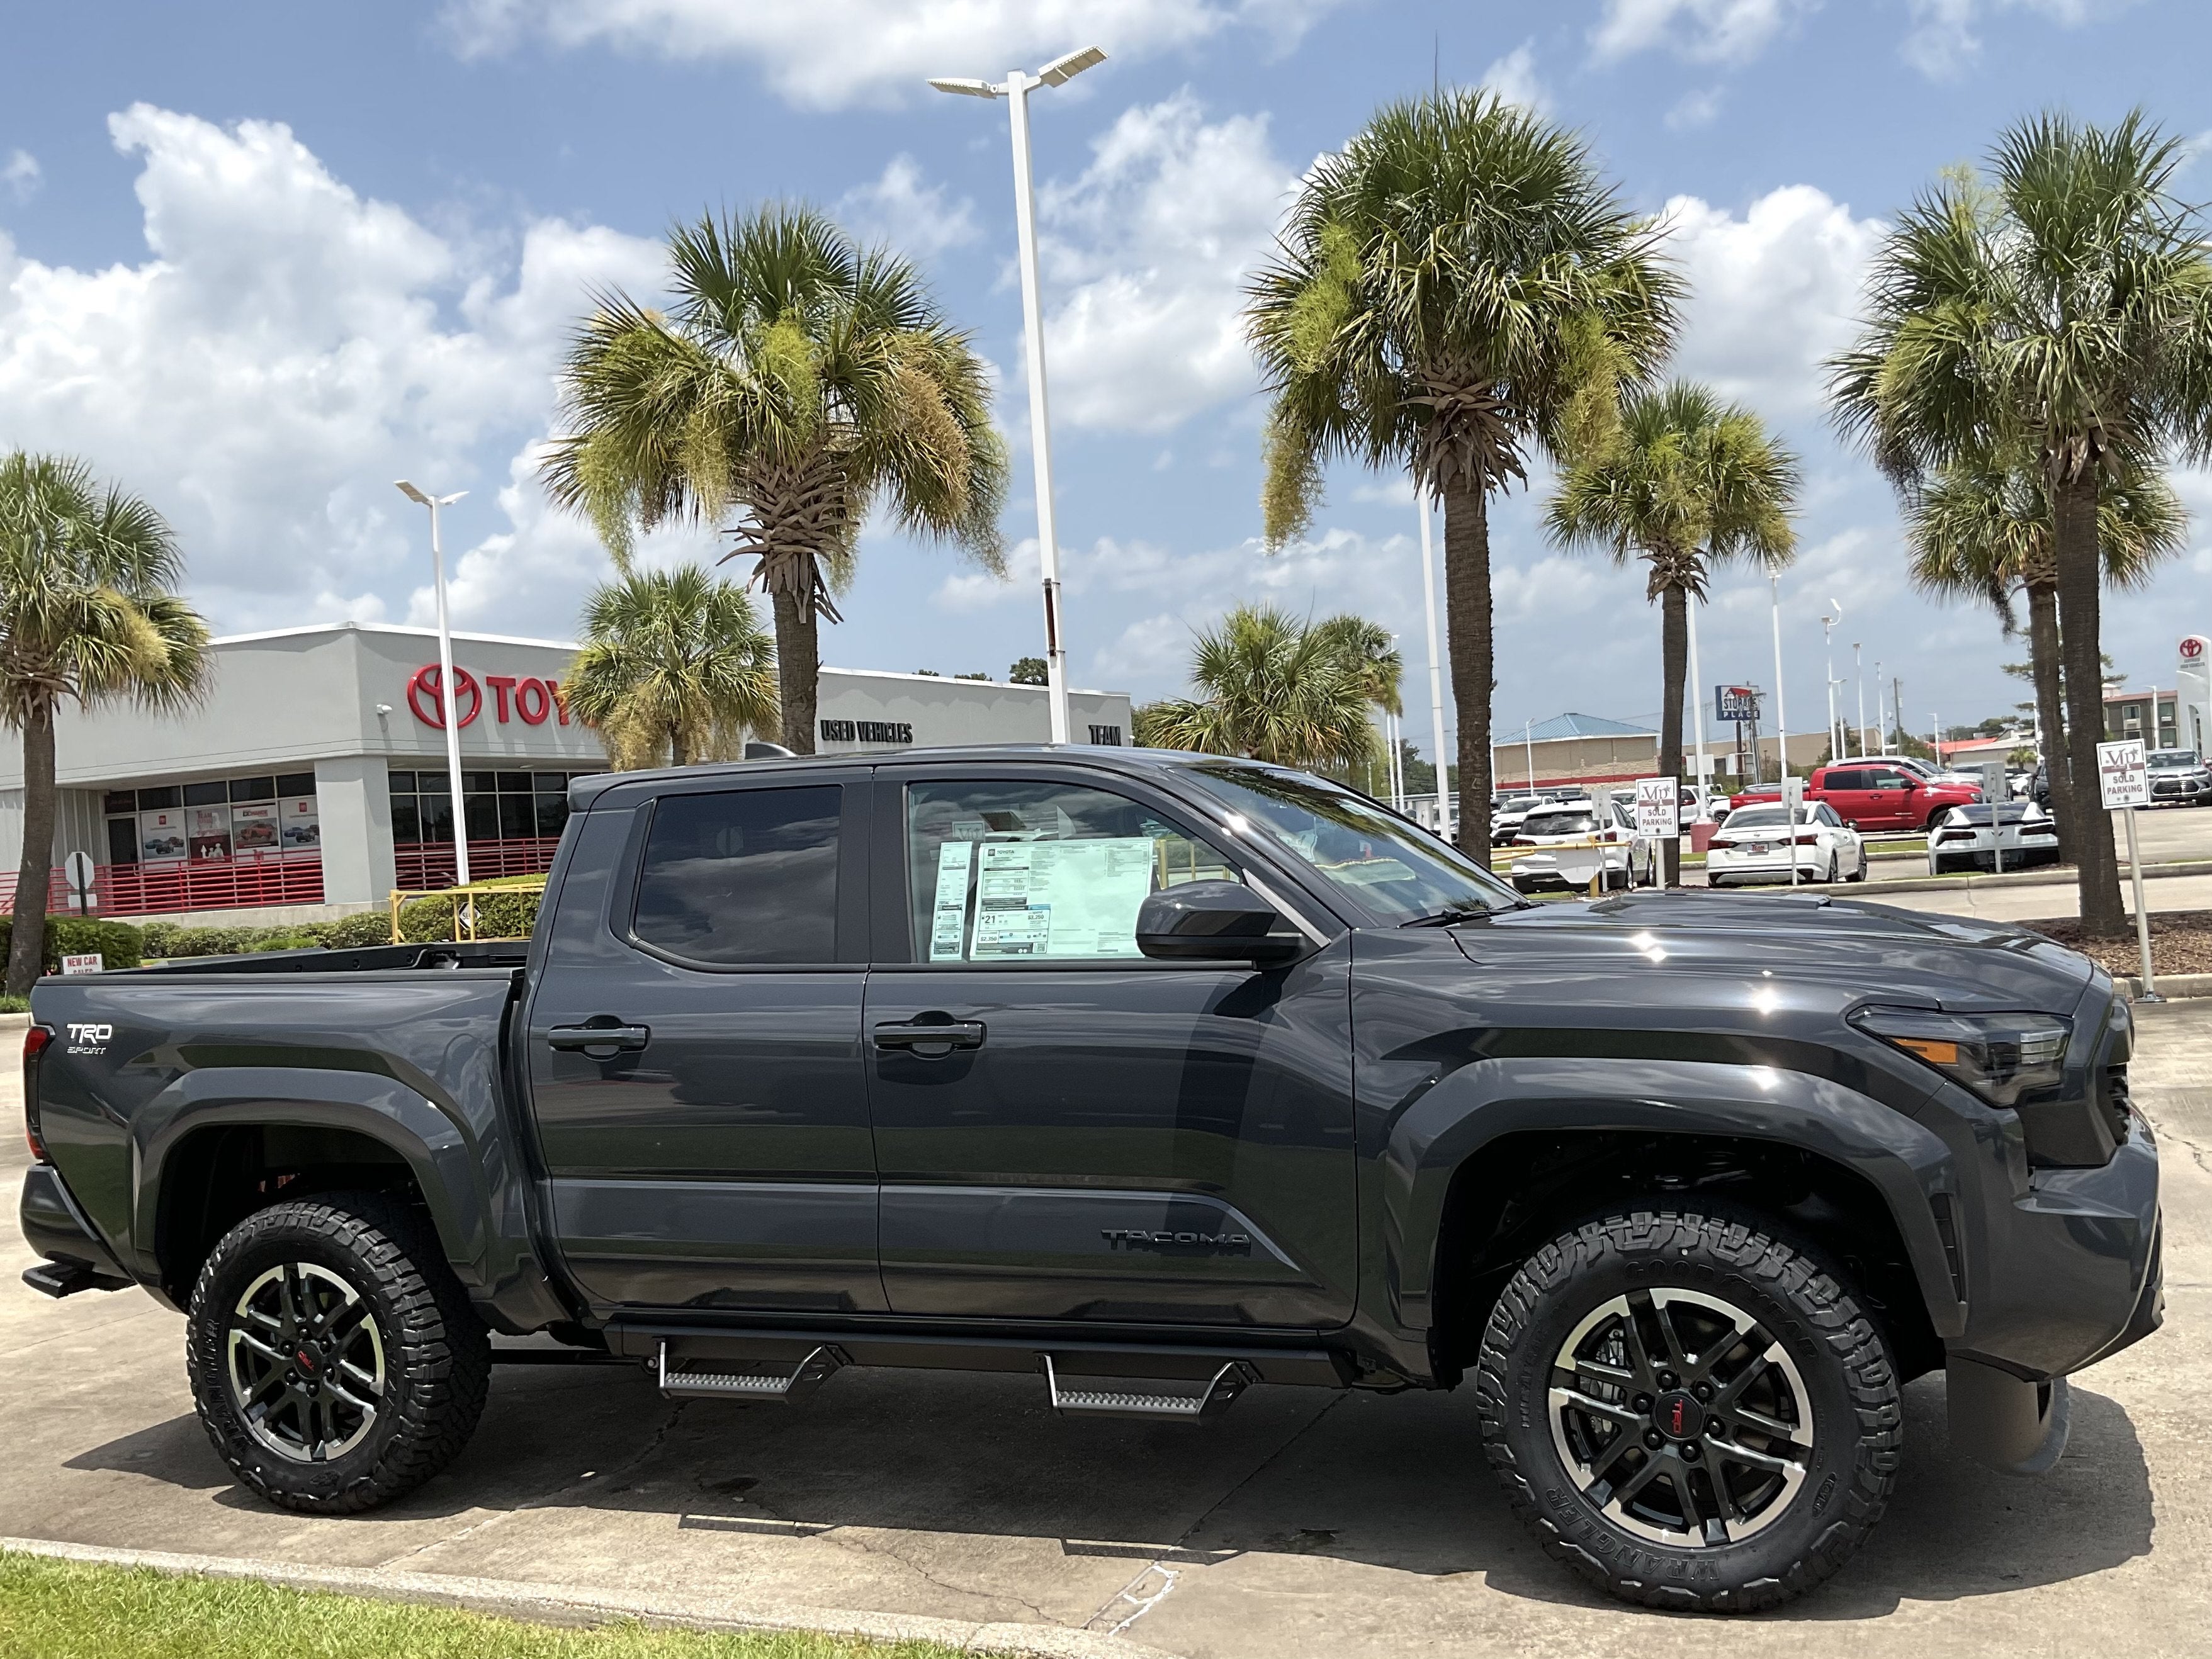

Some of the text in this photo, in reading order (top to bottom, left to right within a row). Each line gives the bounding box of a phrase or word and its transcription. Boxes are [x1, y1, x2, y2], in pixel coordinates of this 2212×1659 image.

[487, 677, 572, 726] TOY
[820, 720, 913, 743] USED VEHICLES
[1088, 724, 1122, 746] TEAM
[2113, 774, 2135, 784] SOLD
[2106, 784, 2143, 795] PARKING
[1647, 809, 1666, 817] SOLD
[1642, 818, 1673, 826] PARKING
[985, 915, 995, 924] 21
[67, 955, 98, 967] NEW CAR
[67, 1023, 113, 1044] TRD
[67, 1046, 106, 1055] SPORT
[1102, 1229, 1251, 1247] TACOMA
